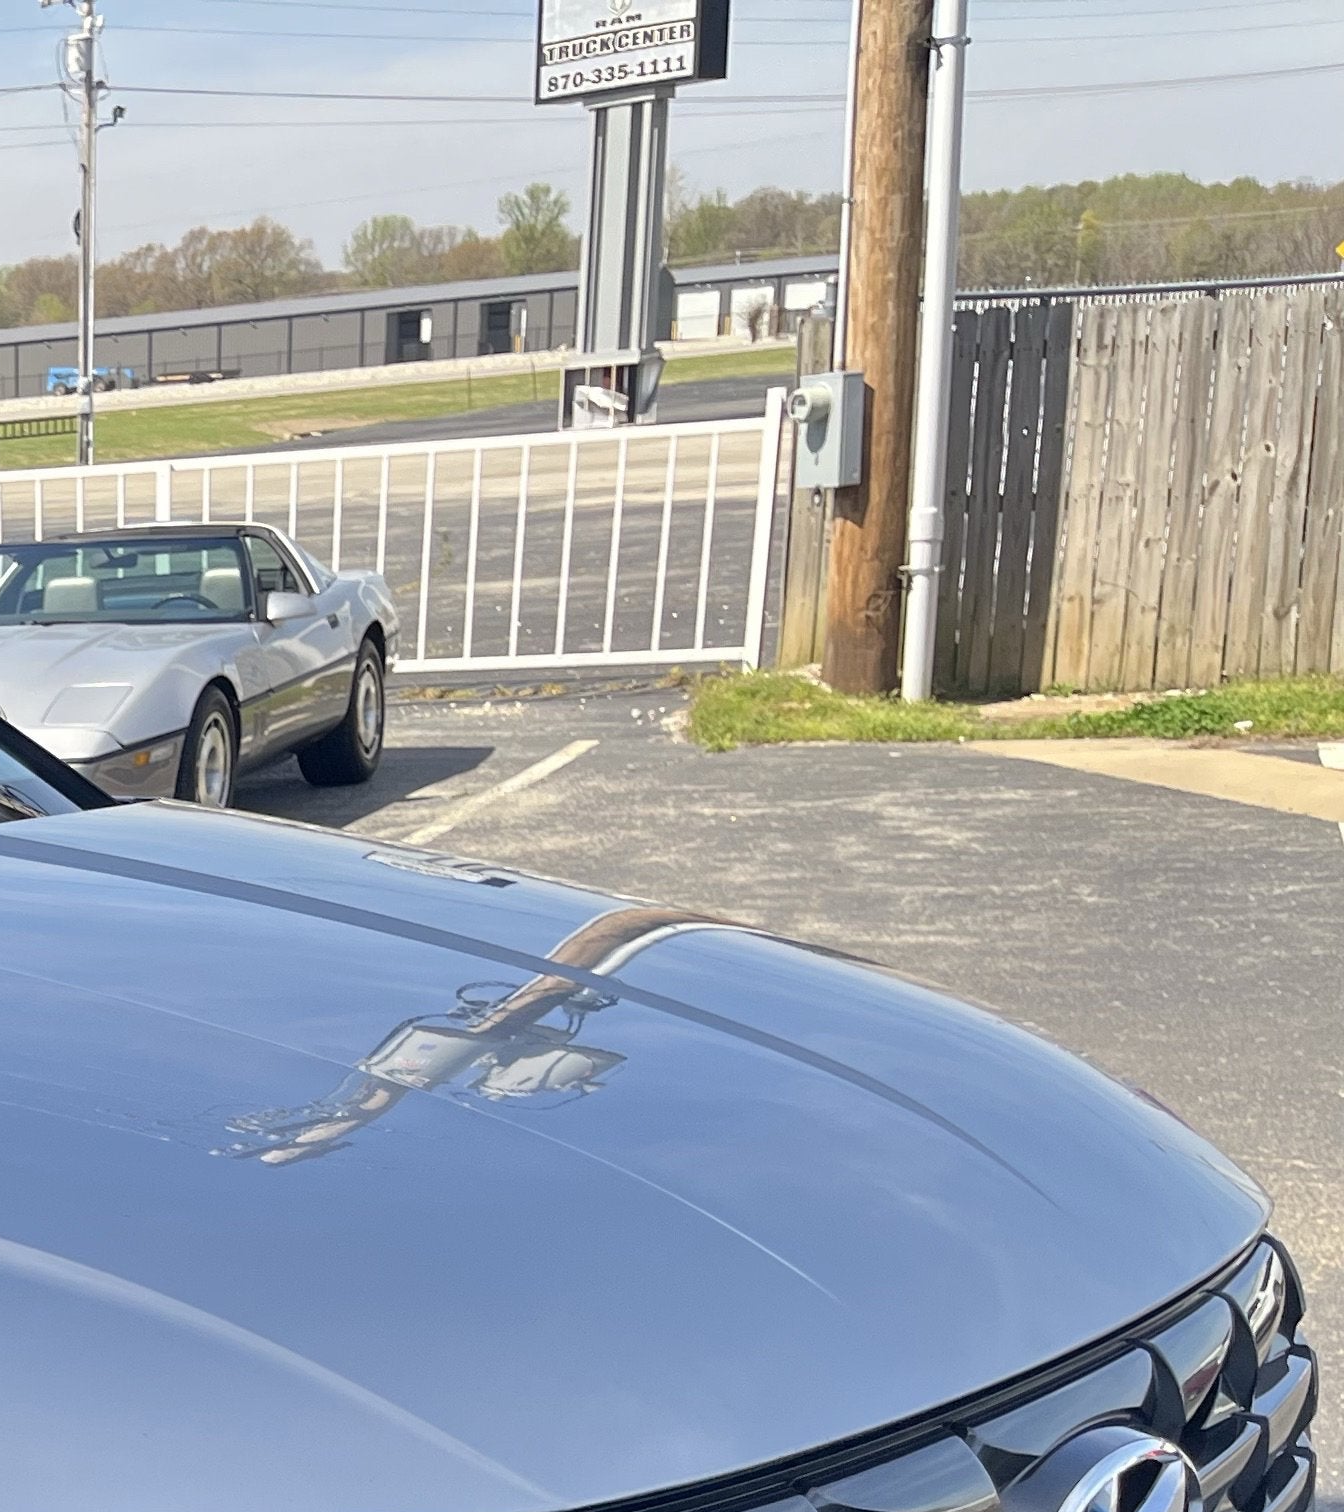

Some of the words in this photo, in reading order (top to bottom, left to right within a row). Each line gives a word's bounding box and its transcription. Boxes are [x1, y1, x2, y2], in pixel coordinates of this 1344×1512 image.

[546, 36, 612, 62] TRUCK
[616, 23, 692, 49] CENTER
[547, 55, 687, 93] 870-335-1111
